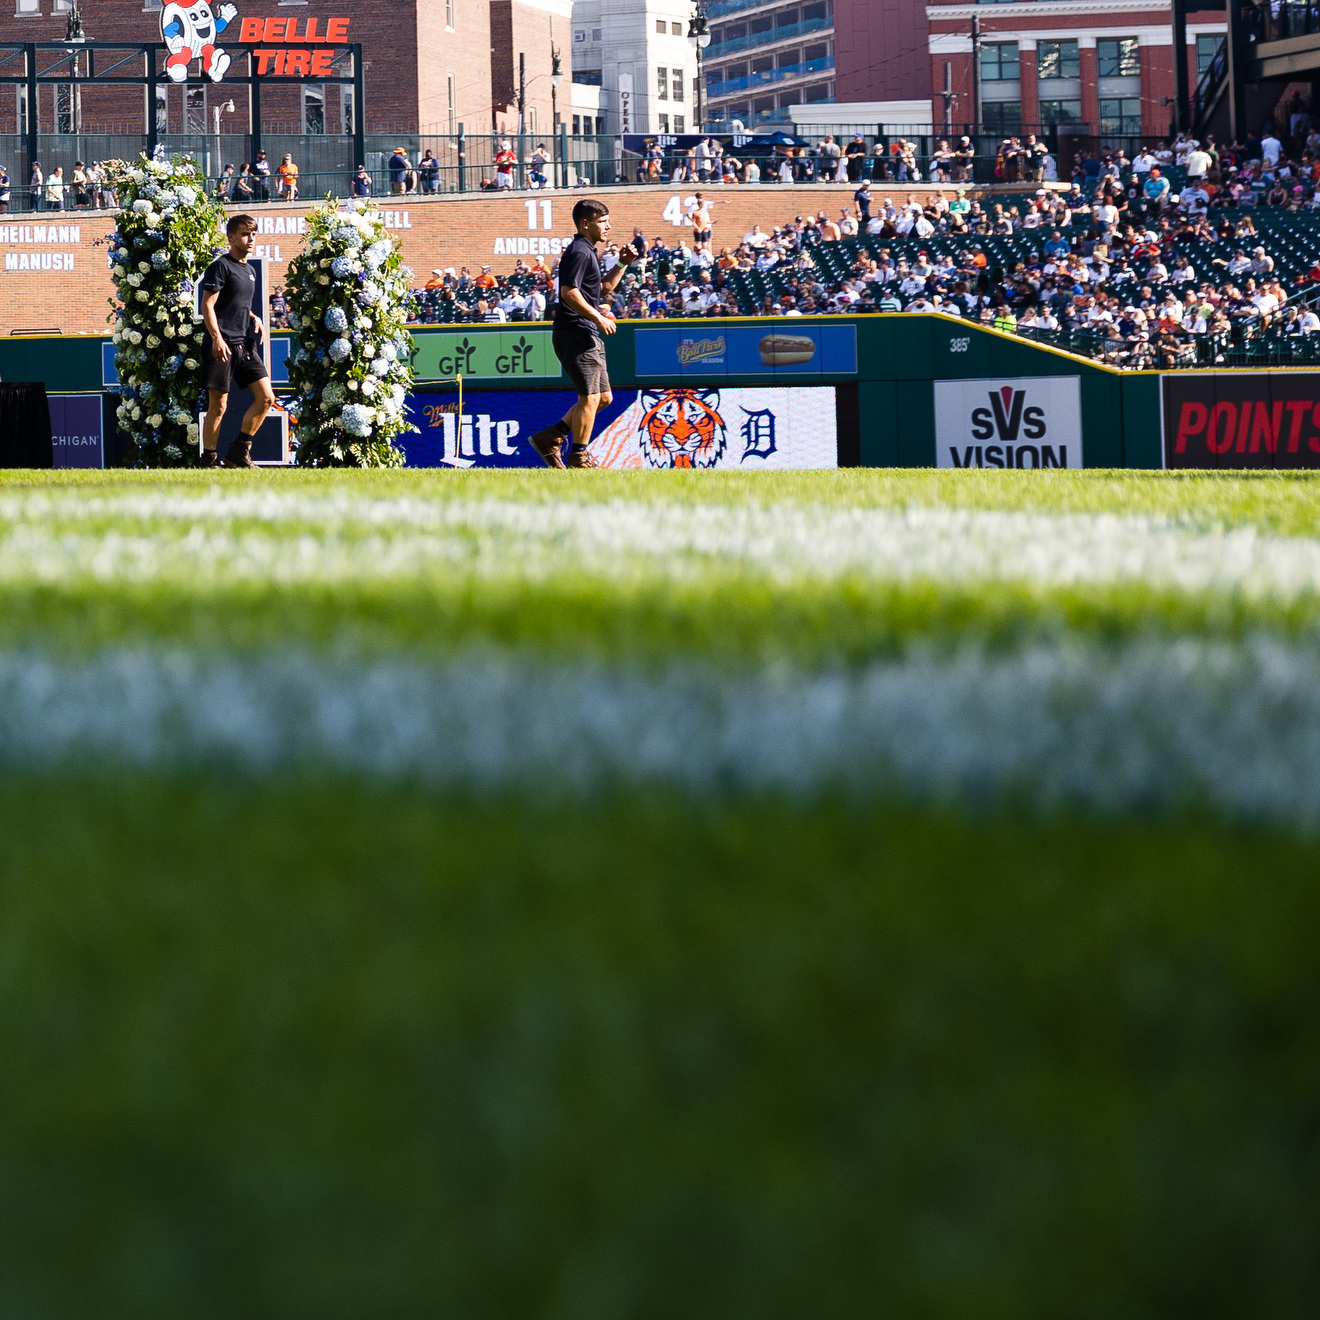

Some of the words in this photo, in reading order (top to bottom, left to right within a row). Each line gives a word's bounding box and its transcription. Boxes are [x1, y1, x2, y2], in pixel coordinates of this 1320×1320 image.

[239, 17, 350, 43] BELLE
[253, 49, 335, 75] TIRE
[621, 91, 630, 133] OPERA
[657, 135, 677, 148] Lite
[524, 199, 553, 230] 11
[247, 245, 284, 262] ELL
[493, 237, 573, 255] ANDERS
[4, 253, 74, 271] MANUSH
[439, 347, 476, 375] GFL
[495, 345, 533, 373] GFL
[52, 435, 98, 446] CHIGAN
[440, 413, 520, 468] Lite
[950, 445, 1067, 468] VISION
